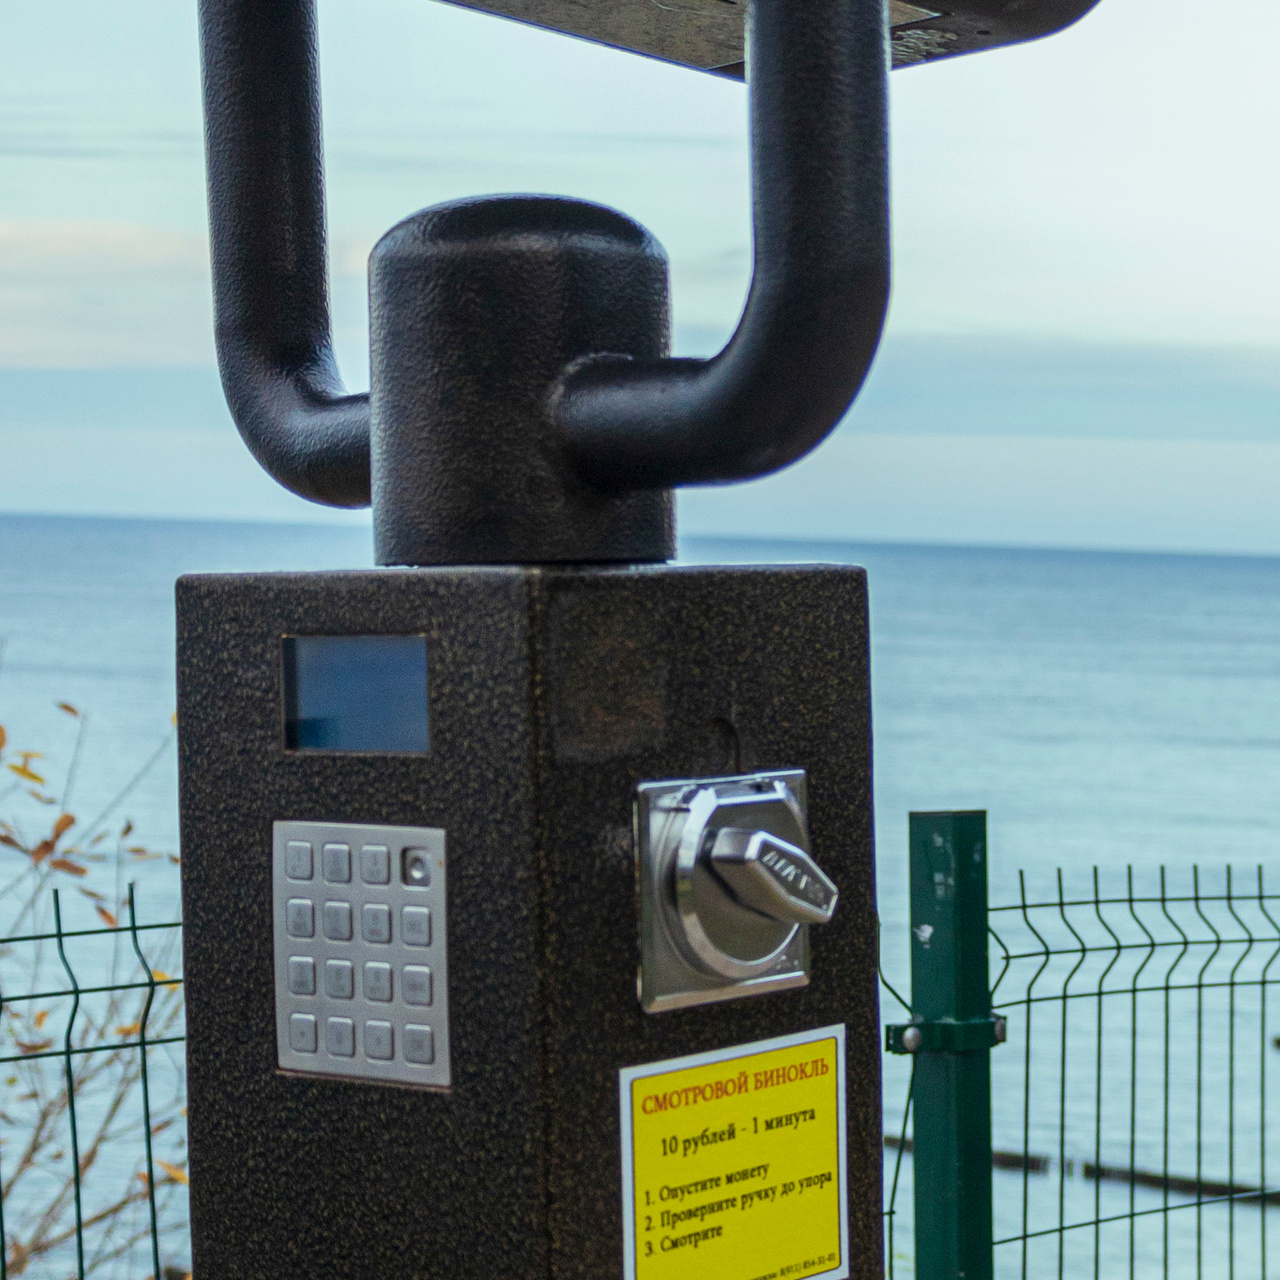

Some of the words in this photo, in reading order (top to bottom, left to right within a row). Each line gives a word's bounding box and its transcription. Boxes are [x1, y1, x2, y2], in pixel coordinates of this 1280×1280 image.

[641, 1070, 750, 1115] СМОТРОВОЙ
[753, 1057, 830, 1091] БИНОКЛЬ
[661, 1135, 679, 1157] 10
[682, 1122, 736, 1157] рублей
[752, 1116, 759, 1134] 1
[764, 1108, 816, 1135] минута
[644, 1189, 656, 1206] 1.
[659, 1176, 722, 1202] Опустите
[725, 1163, 770, 1185] монету
[644, 1214, 656, 1232] 2.
[660, 1195, 738, 1230] Проверните
[740, 1184, 778, 1211] ручку
[780, 1179, 796, 1198] до
[797, 1170, 832, 1195] упора
[660, 1224, 723, 1253] Смотрите
